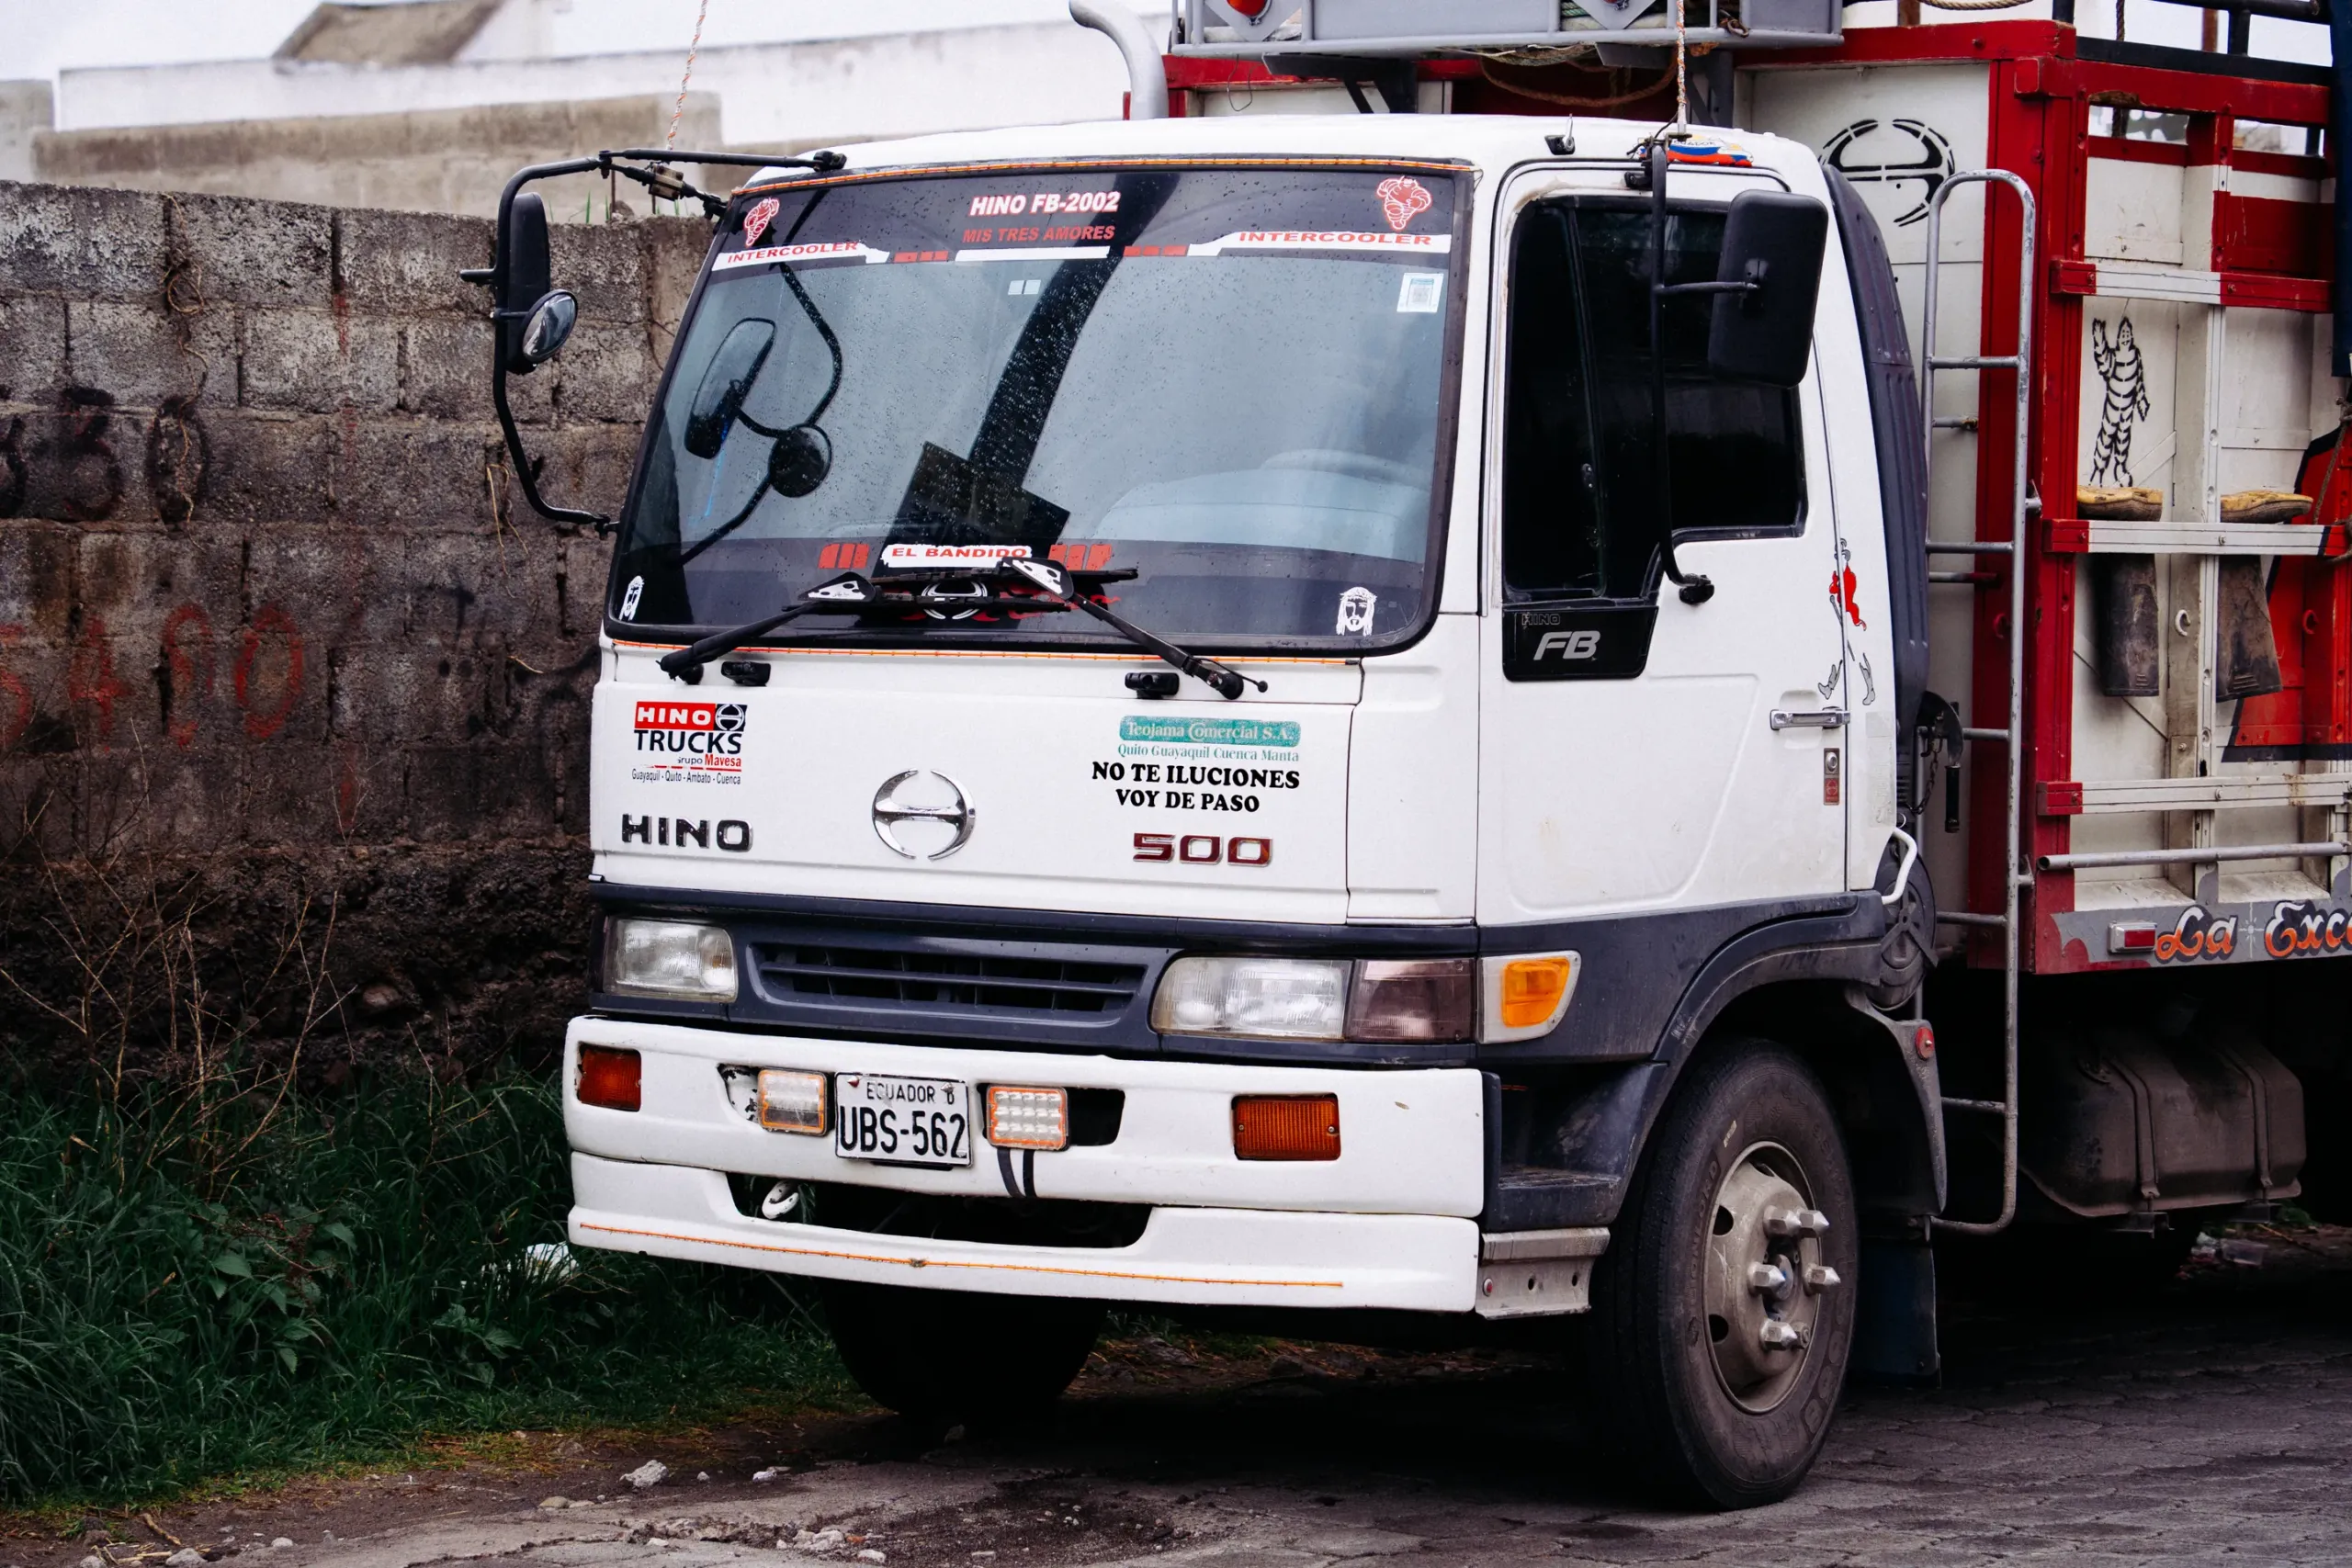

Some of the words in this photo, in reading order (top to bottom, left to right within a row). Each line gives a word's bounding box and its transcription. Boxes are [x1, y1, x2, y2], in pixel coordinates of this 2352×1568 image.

[969, 195, 1026, 217] HINO
[1029, 191, 1121, 214] FB-2002
[963, 229, 992, 243] MIS
[999, 227, 1039, 242] TRES
[1043, 225, 1115, 241] AMORES
[1239, 232, 1432, 245] INTERCOOLER
[728, 242, 858, 263] INTERCOOLER
[891, 547, 916, 558] EL
[926, 547, 1027, 558] BANDIDO
[1521, 614, 1560, 626] HINO
[1533, 630, 1601, 660] FB
[637, 706, 712, 726] HINO
[1128, 721, 1184, 739] Teojama
[1188, 722, 1257, 741] Comercial
[1261, 727, 1295, 740] S.A.
[634, 729, 743, 755] TRUCKS
[705, 753, 742, 767] Mavesa
[1117, 743, 1148, 758] Quito
[1151, 745, 1210, 761] Guayaquil
[1214, 748, 1258, 761] Cuenca
[1261, 750, 1299, 762] Manta
[632, 768, 660, 783] Guayaquil
[665, 771, 682, 782] Quito
[686, 772, 711, 784] Ambato
[717, 773, 741, 784] Cuenca
[1092, 761, 1125, 781] NO
[1131, 763, 1160, 783] TE
[1166, 765, 1300, 789] ILUCIONES
[1115, 789, 1159, 807] VOY
[1165, 791, 1194, 809] DE
[1201, 793, 1260, 812] PASO
[622, 813, 753, 852] HINO
[1133, 832, 1273, 867] 500
[2155, 905, 2237, 960] La
[2265, 901, 2352, 957] Exc
[866, 1082, 935, 1102] ECUADOR
[840, 1106, 967, 1159] UBS-562
